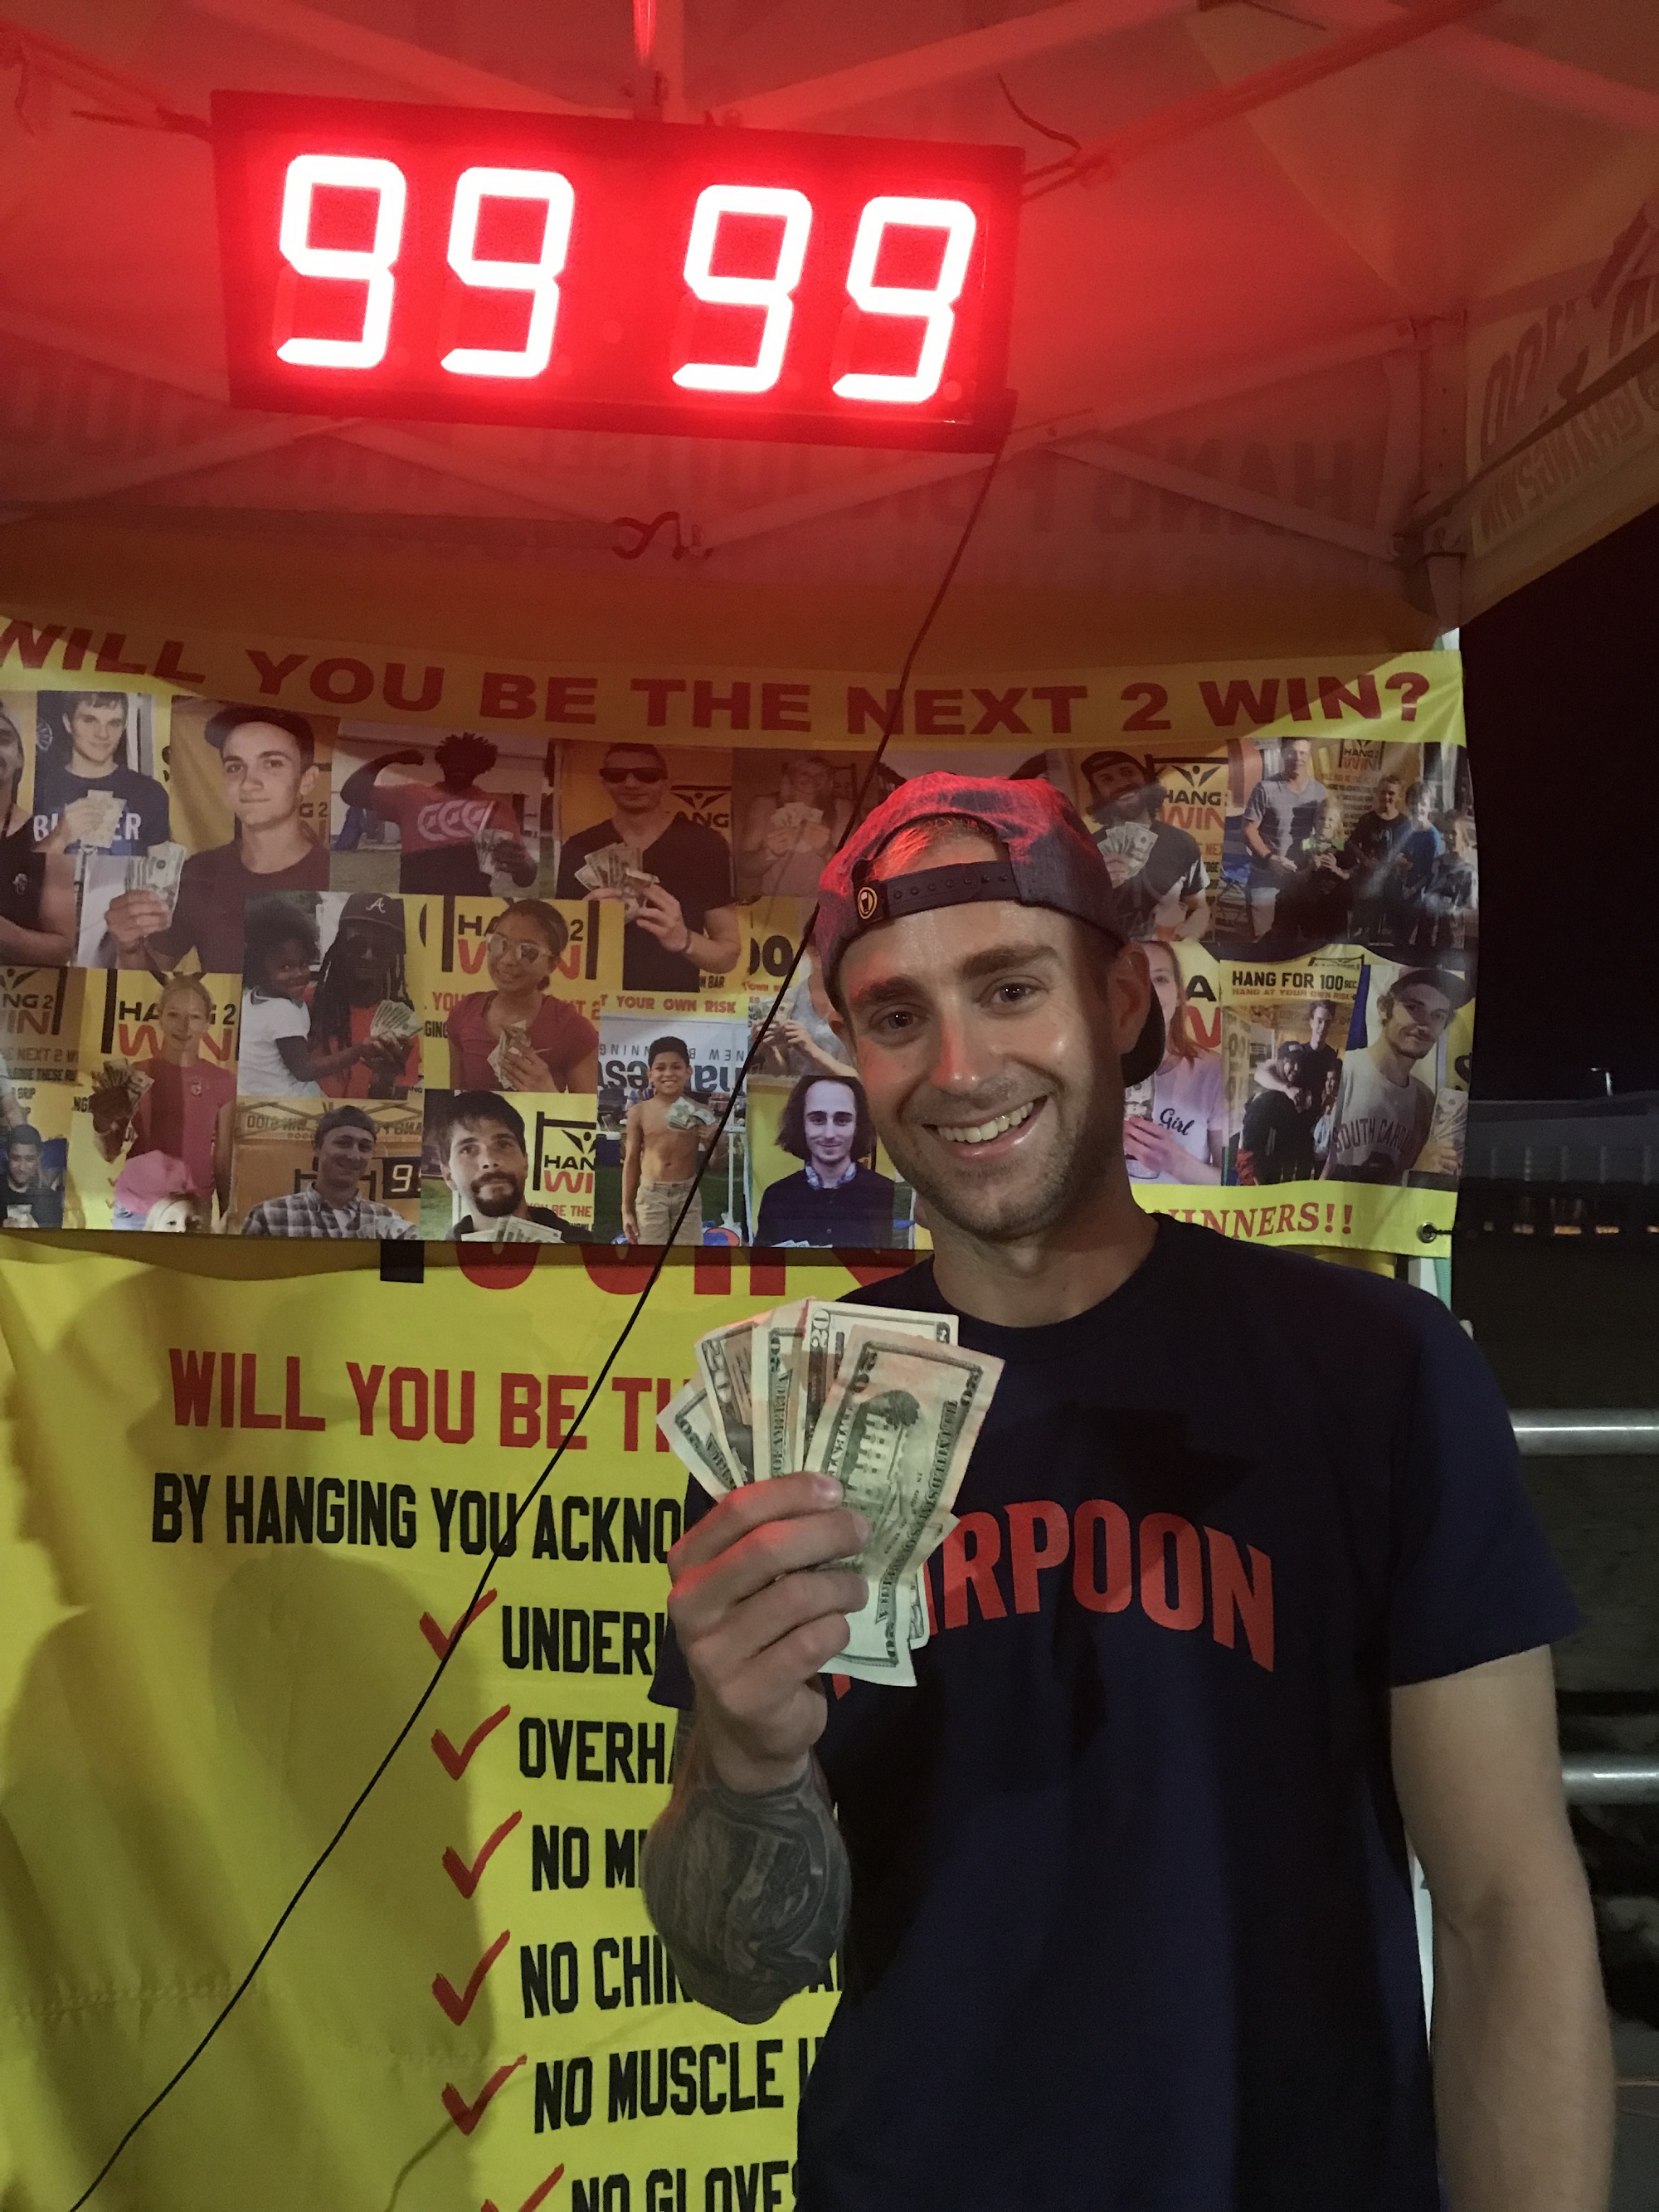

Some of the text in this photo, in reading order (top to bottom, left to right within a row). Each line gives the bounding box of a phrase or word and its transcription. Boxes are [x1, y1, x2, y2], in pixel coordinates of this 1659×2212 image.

[276, 153, 977, 404] 99 99
[0, 621, 1431, 736] WILL YOU BE THE NEXT 2 WIN?
[667, 811, 729, 828] ANG
[1232, 971, 1276, 987] HANG
[1281, 972, 1314, 988] FOR
[222, 1003, 236, 1026] 2
[617, 996, 654, 1010] YOUR
[664, 999, 696, 1011] OWN
[705, 1000, 736, 1014] RISK
[17, 1048, 51, 1062] NEXT
[54, 1049, 63, 1062] 2
[119, 1023, 232, 1061] WN
[1160, 1108, 1195, 1136] Girl
[1332, 1118, 1375, 1153] SOUTH
[571, 1206, 593, 1218] THE
[1145, 1202, 1353, 1240] INNERS!!
[169, 1348, 325, 1432] WILL
[346, 1362, 475, 1445] YOU
[500, 1372, 588, 1451] BE
[152, 1473, 687, 1565] BY HANGING YOU ACKNO
[832, 1498, 1275, 1699] RPOON
[518, 1717, 676, 1785] OVERH
[532, 1825, 590, 1893] NO
[520, 1942, 579, 2019] NO
[534, 2056, 593, 2134] NO
[607, 2039, 784, 2123] MUSCLE
